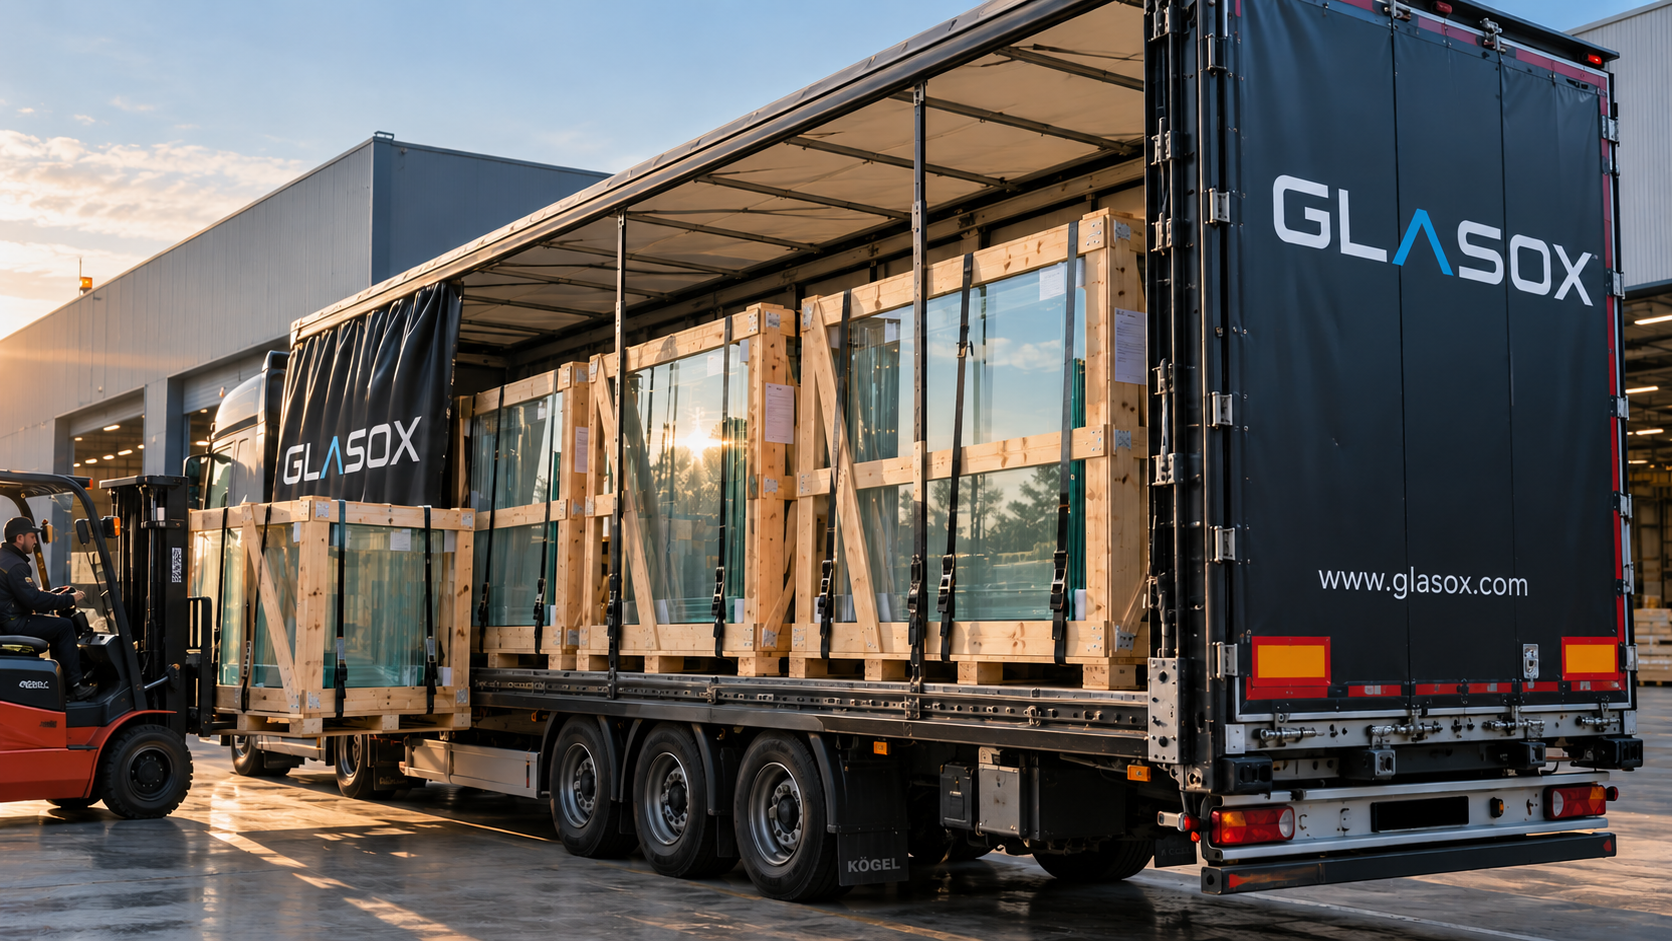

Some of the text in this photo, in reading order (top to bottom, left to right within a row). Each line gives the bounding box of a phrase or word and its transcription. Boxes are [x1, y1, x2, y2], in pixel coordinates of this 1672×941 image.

[1273, 174, 1594, 307] GLASOX
[283, 416, 422, 485] GLASOX
[1318, 566, 1529, 600] www.glasox.com
[848, 856, 901, 873] KÖGEL
